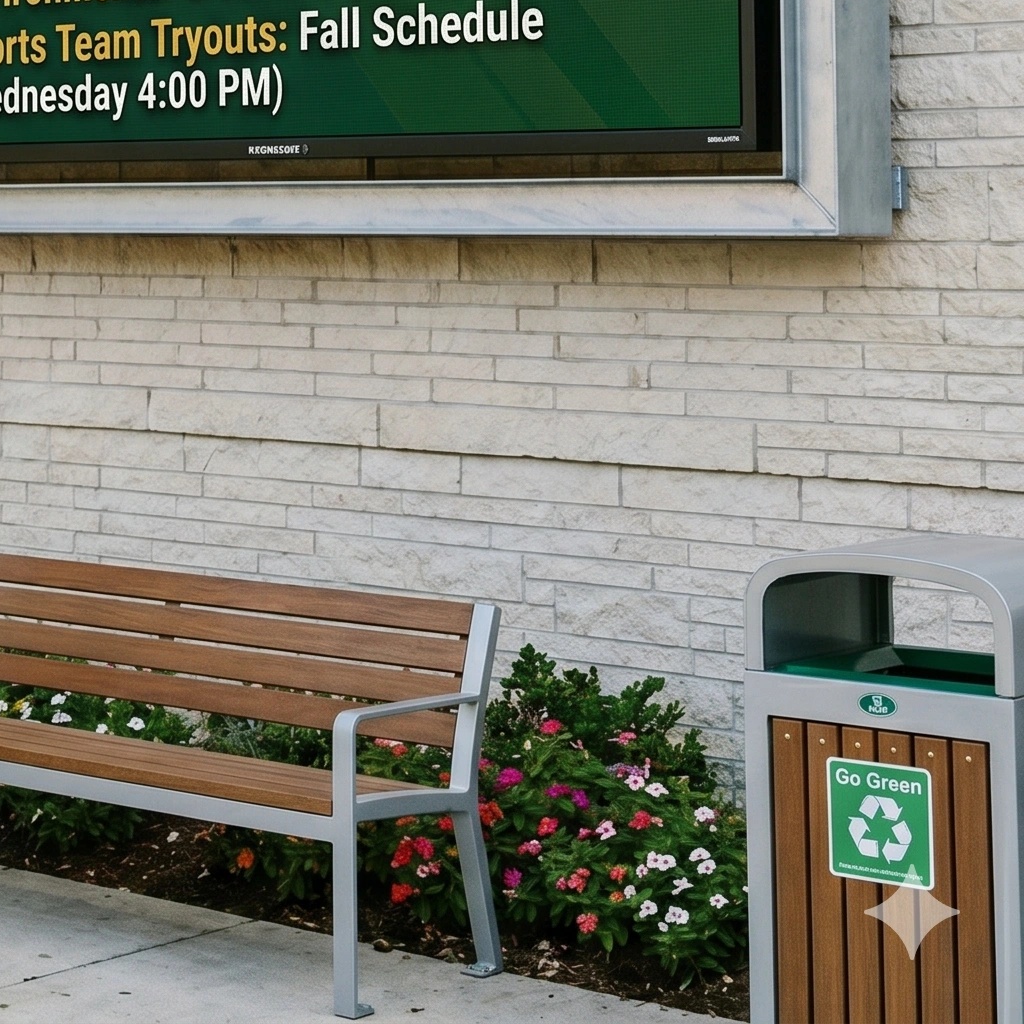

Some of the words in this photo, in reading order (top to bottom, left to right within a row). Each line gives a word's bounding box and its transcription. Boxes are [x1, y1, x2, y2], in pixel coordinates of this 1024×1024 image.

[55, 23, 141, 62] Team
[150, 16, 287, 67] Tryouts:
[300, 6, 360, 51] Fall
[137, 69, 207, 109] 4:00
[218, 63, 283, 116] PM)
[835, 768, 861, 787] Go
[866, 772, 922, 795] Green
